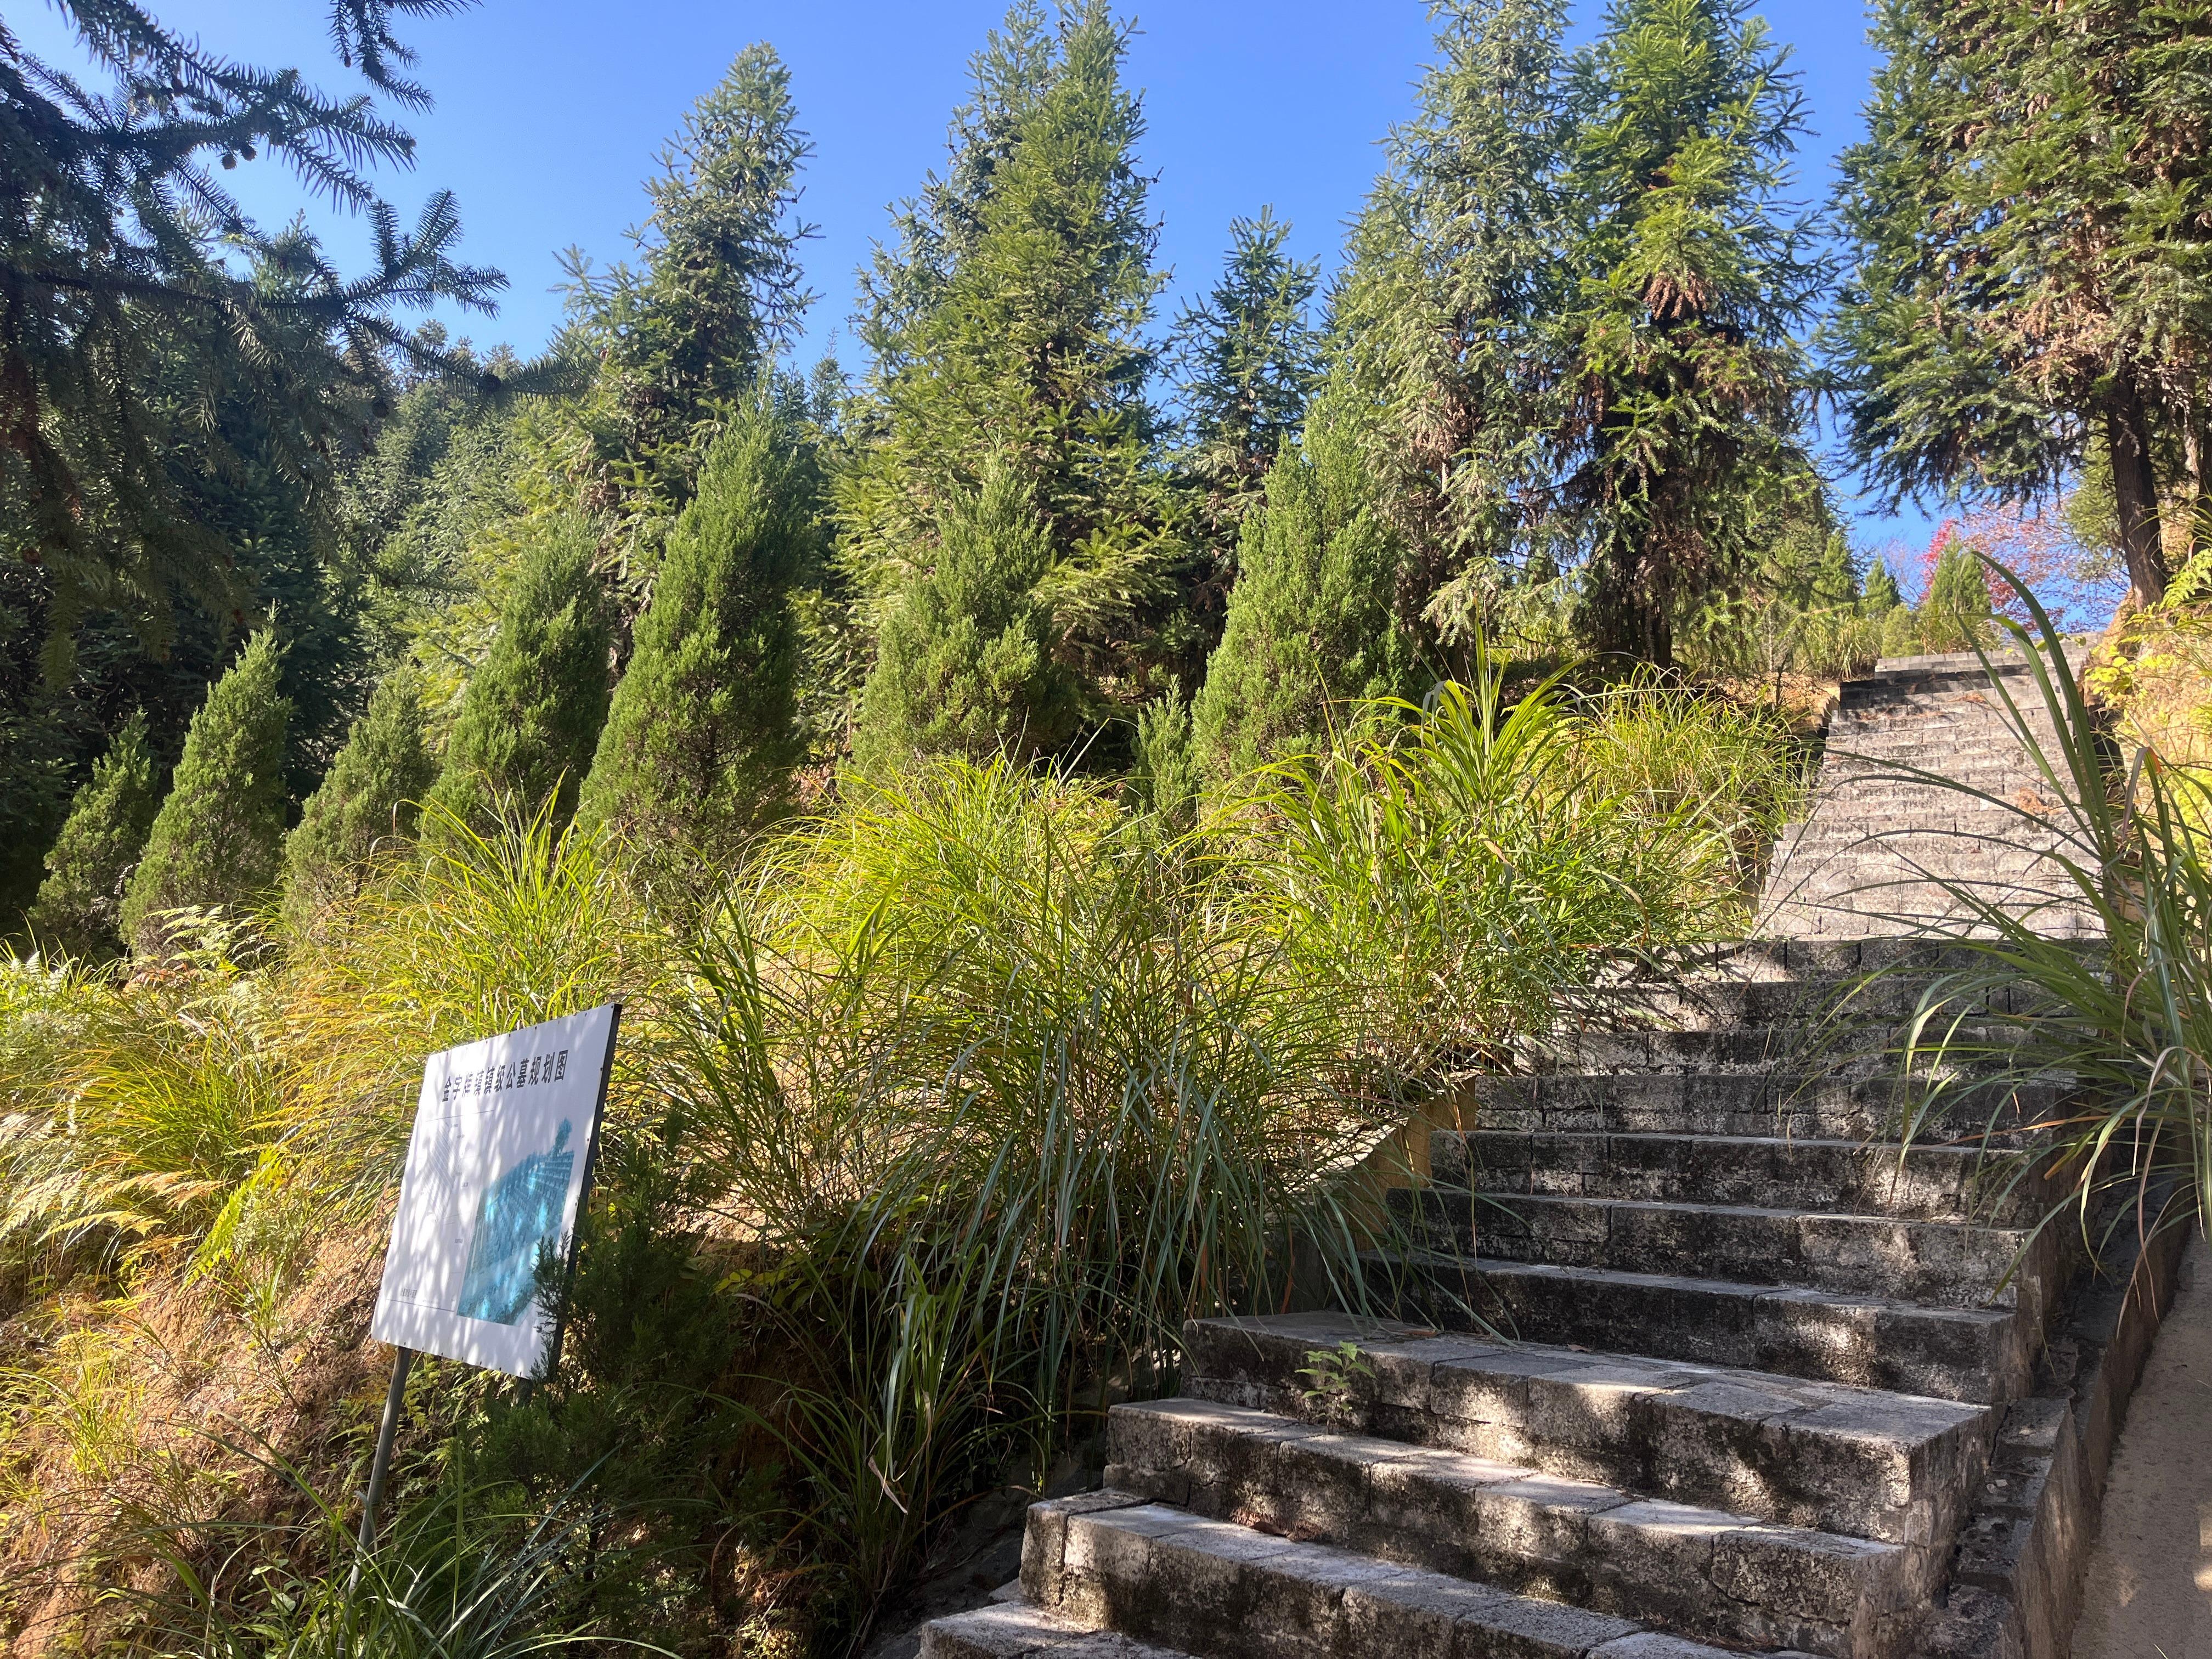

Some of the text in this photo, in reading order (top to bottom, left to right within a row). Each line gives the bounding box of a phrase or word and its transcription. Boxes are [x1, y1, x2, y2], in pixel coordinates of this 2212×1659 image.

[442, 1049, 568, 1102] 金字牌镇镇级公墓规划图
